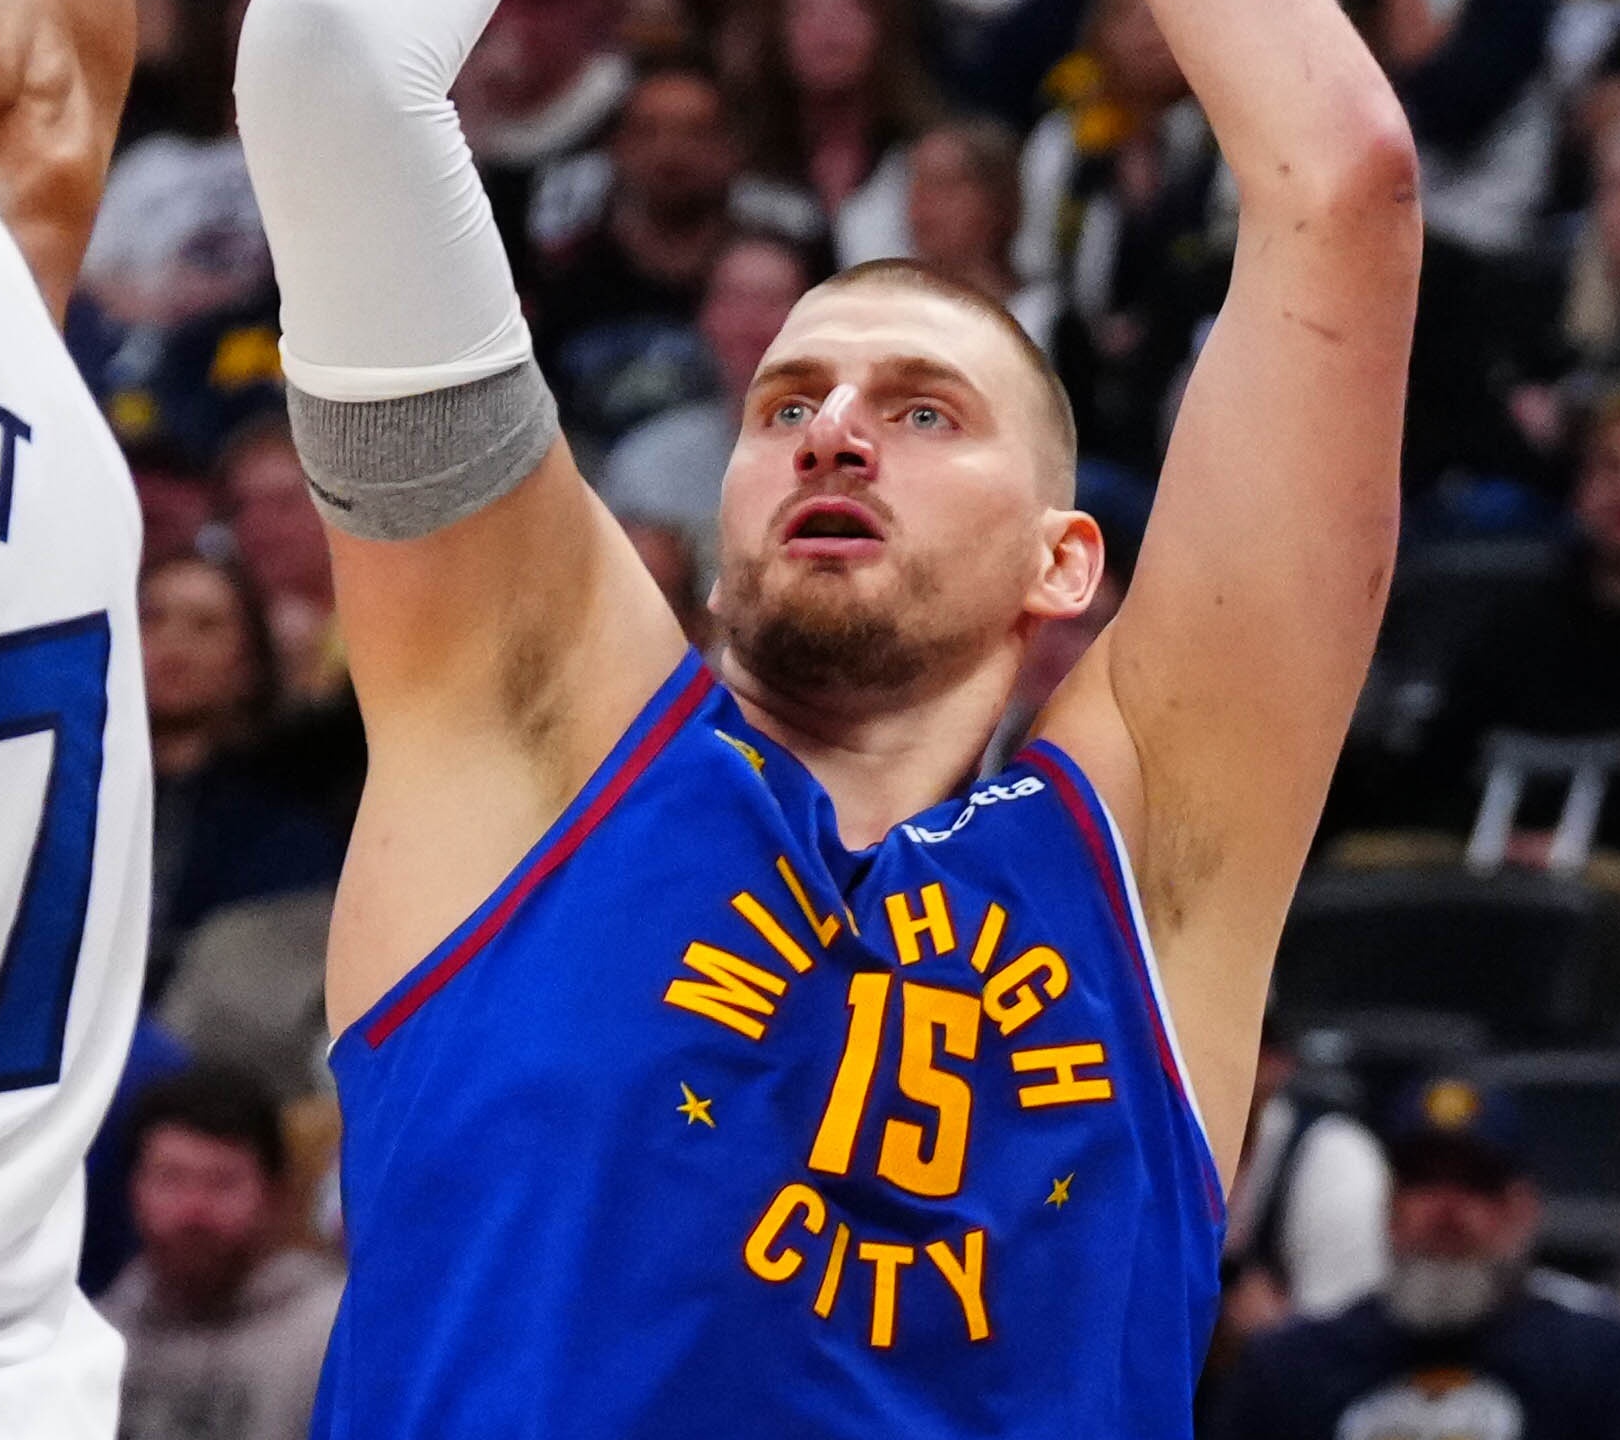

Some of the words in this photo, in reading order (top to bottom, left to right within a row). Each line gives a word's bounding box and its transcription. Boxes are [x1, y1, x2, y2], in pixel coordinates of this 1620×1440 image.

[901, 775, 1046, 844] ibotta
[663, 855, 861, 1041] MIL
[884, 881, 1114, 1109] HIGH
[807, 970, 983, 1198] 15
[742, 1182, 991, 1348] CITY
